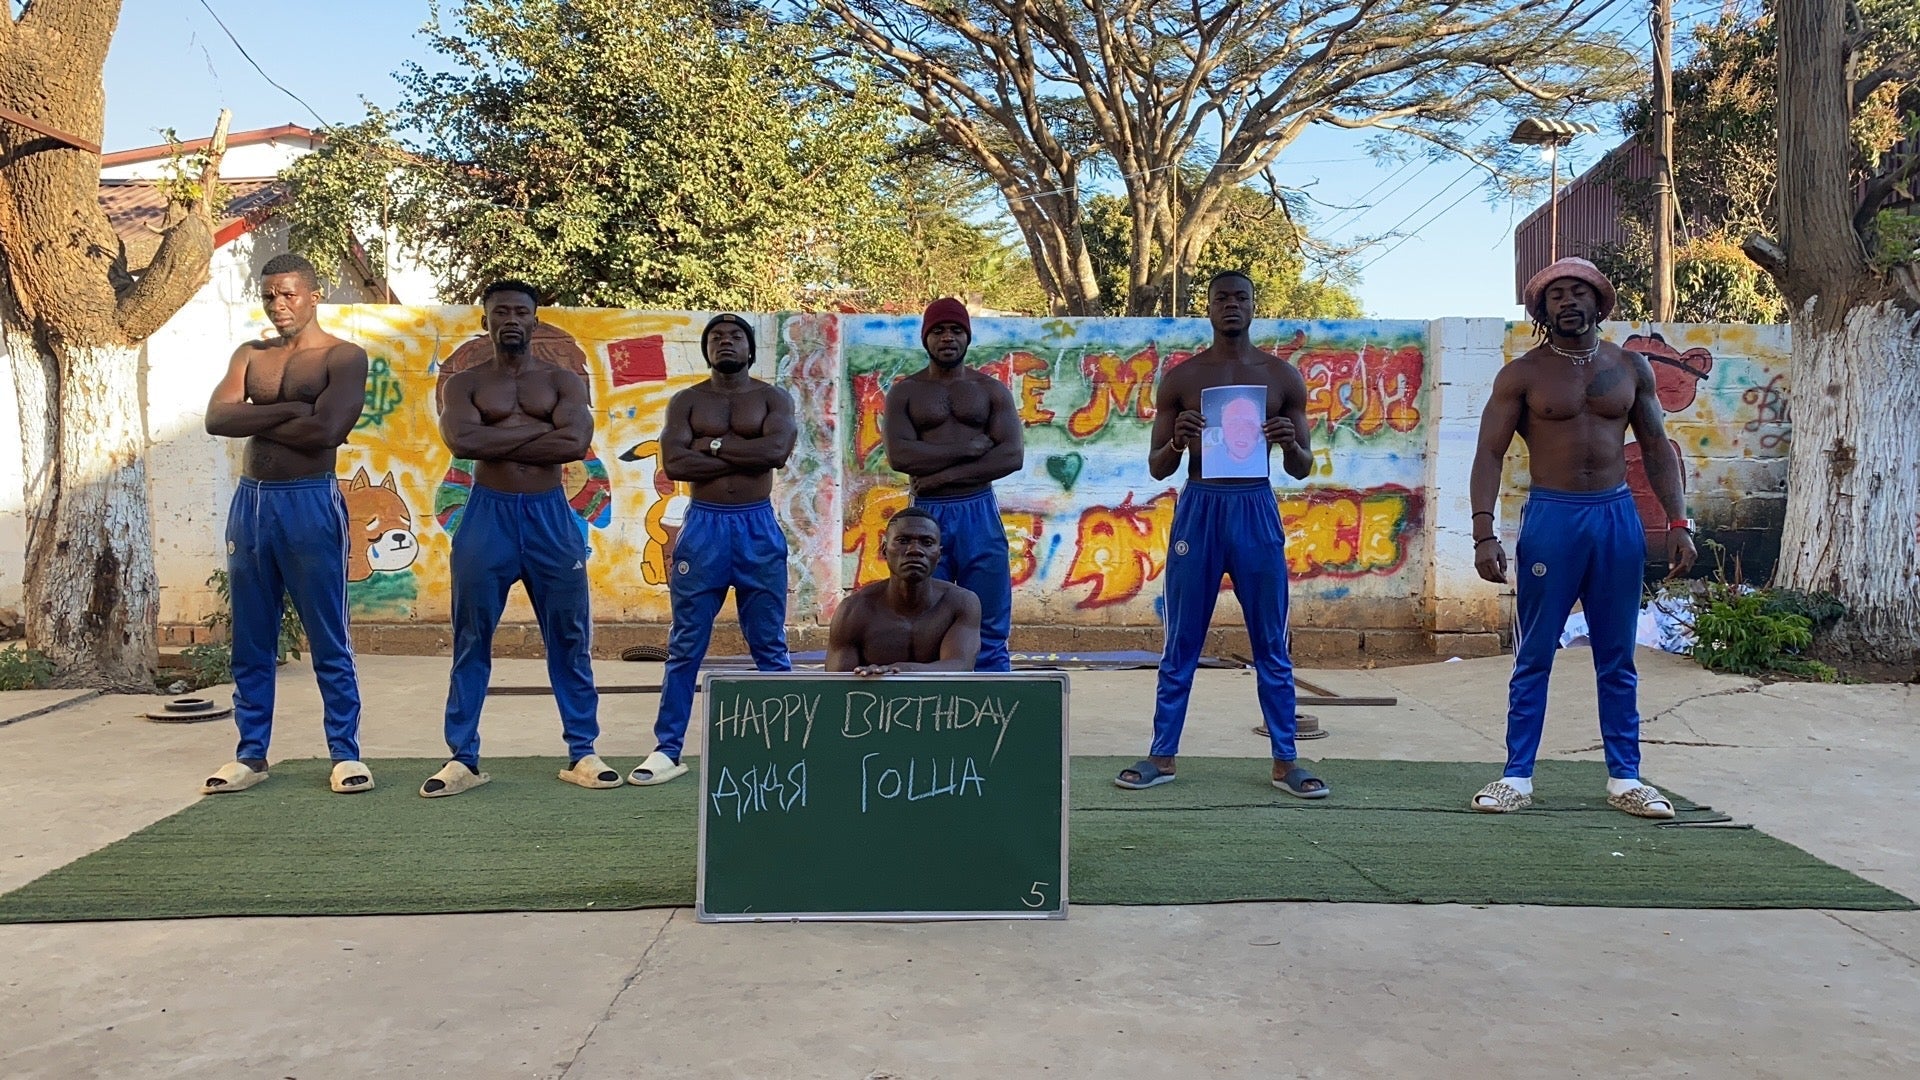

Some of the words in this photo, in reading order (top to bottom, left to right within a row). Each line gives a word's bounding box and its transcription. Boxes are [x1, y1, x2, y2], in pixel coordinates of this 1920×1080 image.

[715, 693, 821, 749] HAPPY
[841, 691, 1020, 766] BIRTHDAY
[1020, 881, 1049, 908] 5
